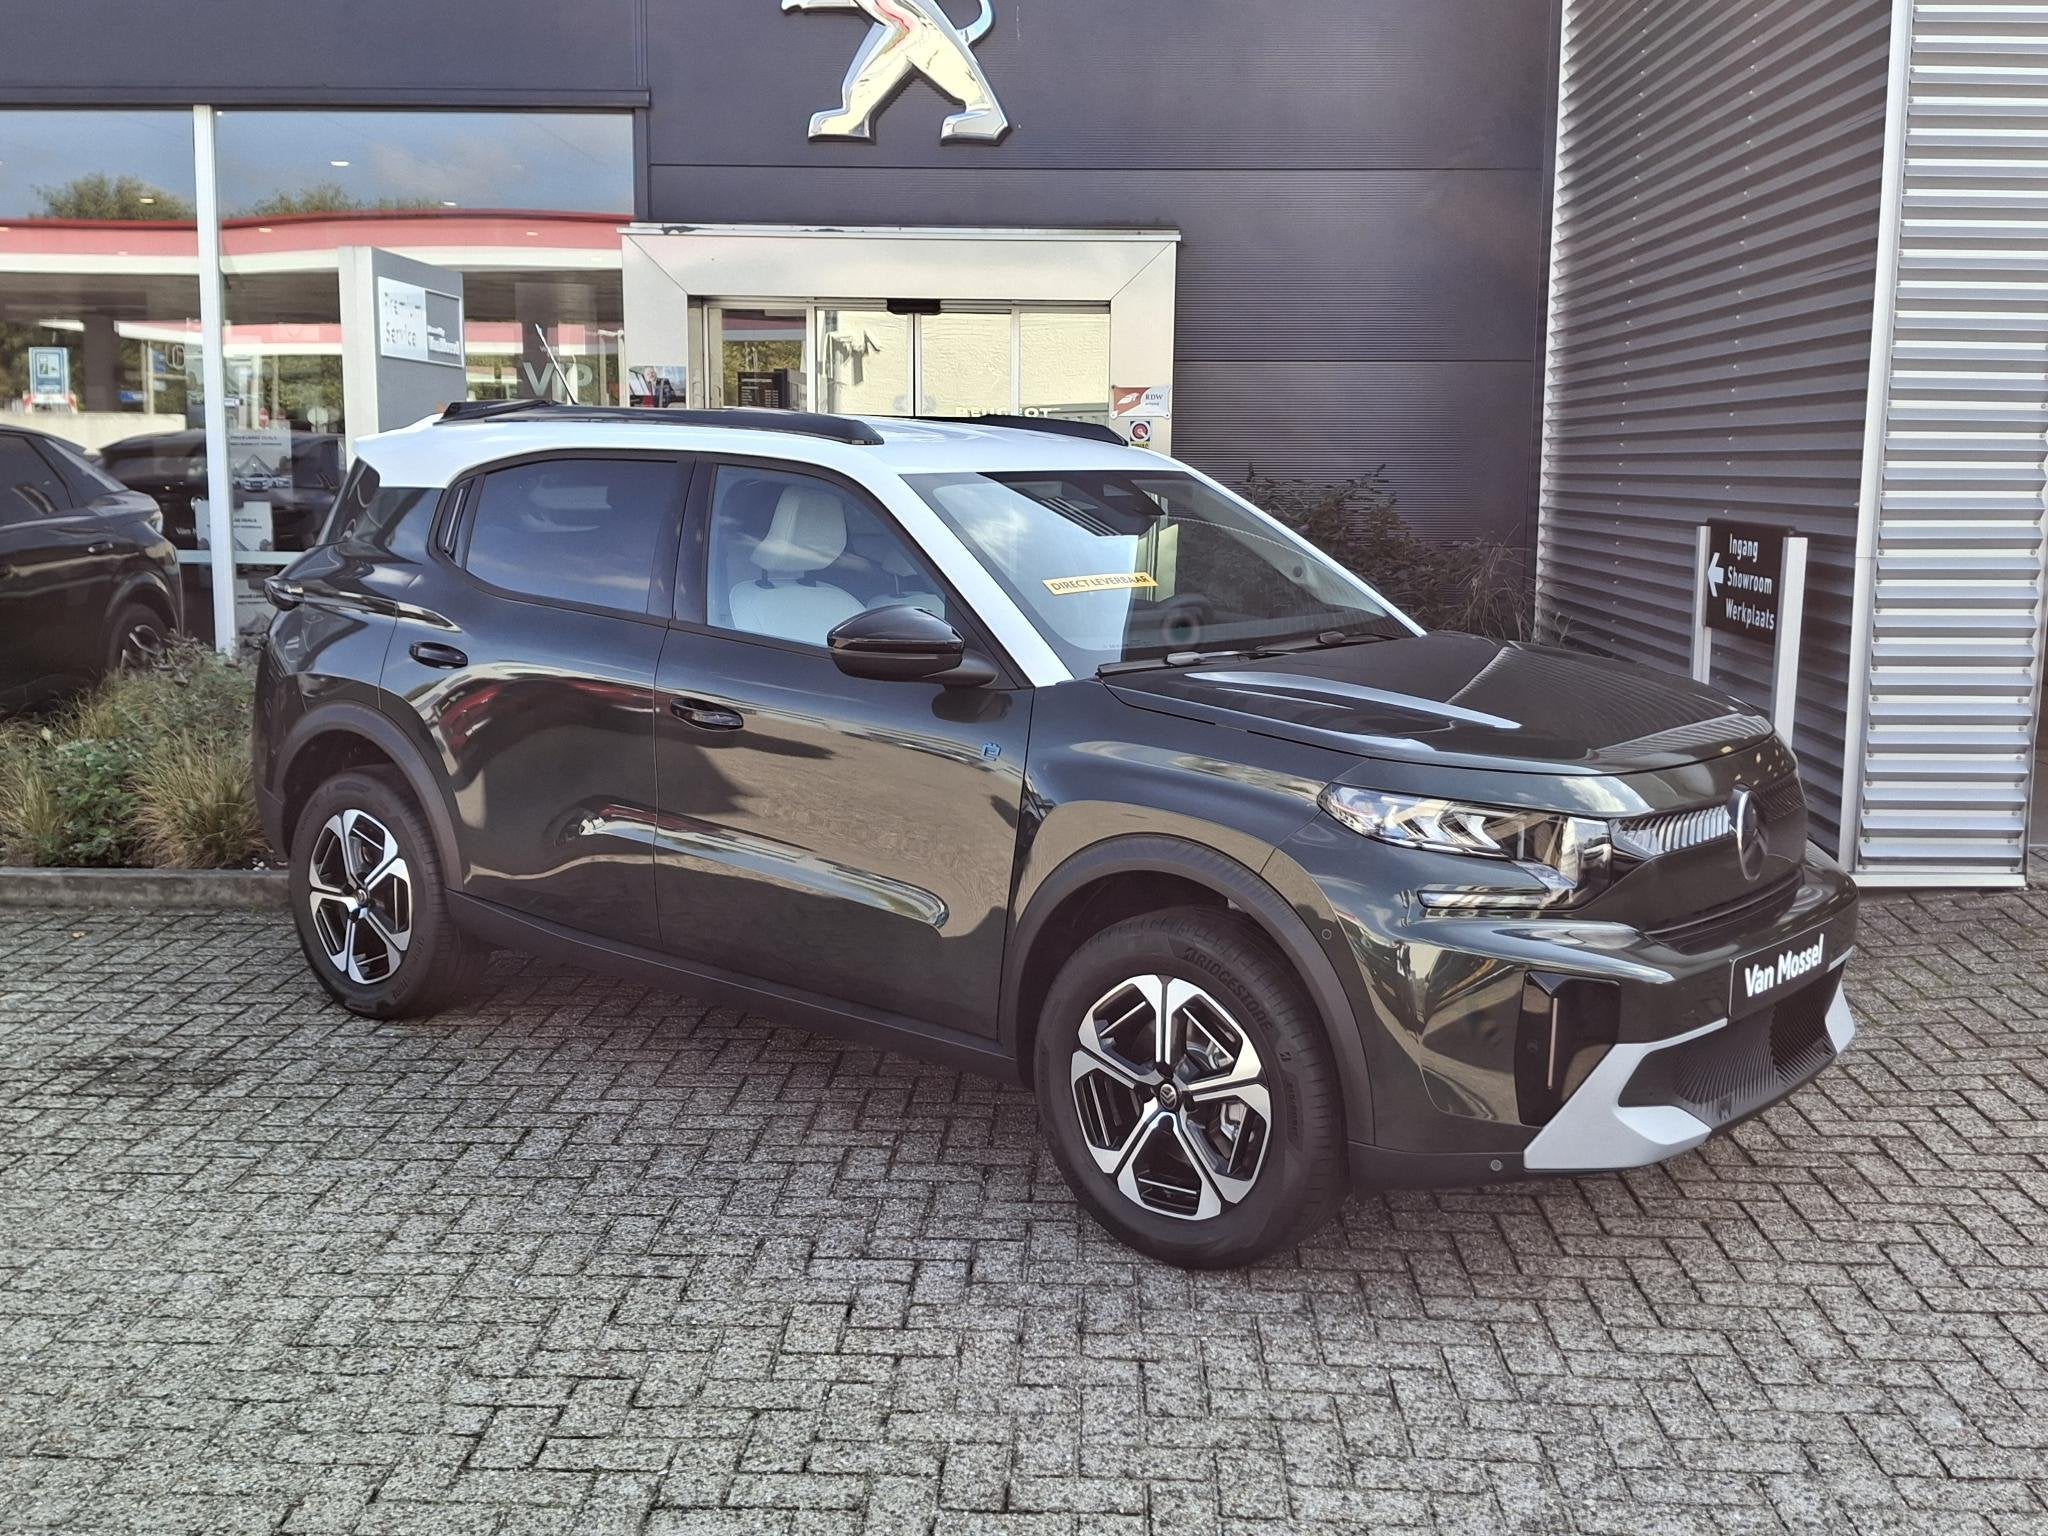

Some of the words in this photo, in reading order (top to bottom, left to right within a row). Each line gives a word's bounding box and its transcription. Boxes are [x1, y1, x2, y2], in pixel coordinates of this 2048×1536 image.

[1728, 532, 1759, 563] Ingang
[1050, 579, 1090, 591] DIRECT
[1091, 575, 1152, 587] LEVERBAAR
[1727, 564, 1773, 595] Showroom
[1725, 597, 1775, 630] Werkplaats
[1744, 962, 1775, 998] Van
[1776, 932, 1825, 985] Mossel
